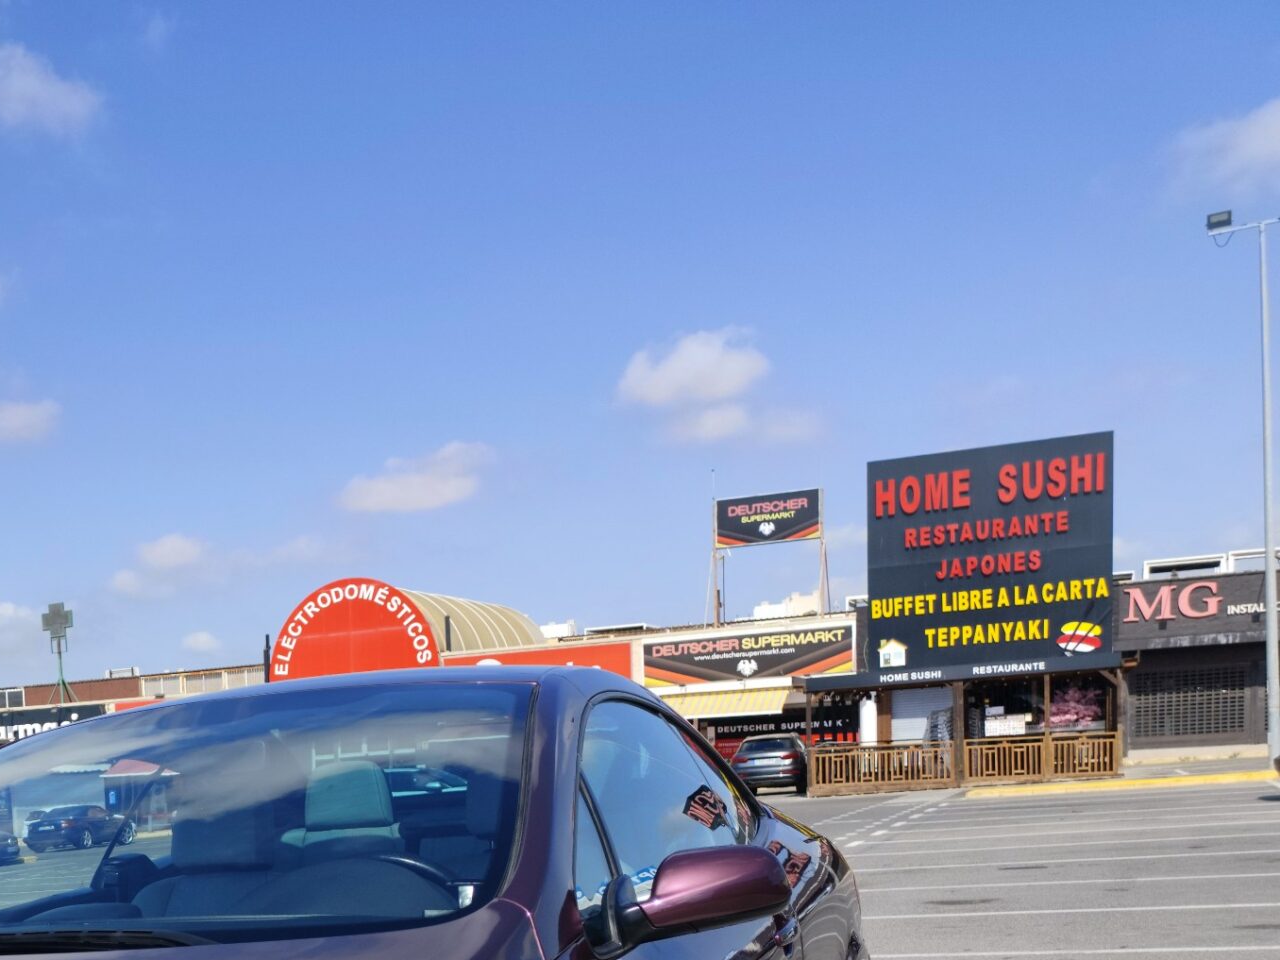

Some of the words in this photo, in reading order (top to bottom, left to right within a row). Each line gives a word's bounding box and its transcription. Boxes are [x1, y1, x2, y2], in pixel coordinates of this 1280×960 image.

[875, 469, 972, 518] HOME
[997, 452, 1106, 505] SUSHI
[727, 497, 808, 517] DEUTSCHER
[741, 510, 796, 523] SUPERMARKT
[904, 510, 1069, 550] RESTAURANTE
[935, 550, 1042, 581] JAPONES
[871, 593, 936, 620] BUFFET
[941, 588, 993, 613] LIBRE
[997, 586, 1011, 608] A
[1014, 584, 1039, 606] LA
[1041, 577, 1109, 604] CARTA
[1122, 581, 1224, 624] MG
[274, 583, 432, 676] ELECTRODOMÉSTICOS
[652, 639, 740, 658] DEUTSCHER
[741, 629, 845, 650] SUPERMARKT
[924, 618, 1050, 649] TEPPANYAKI
[693, 647, 796, 662] www.deutschersupermarkt.com
[972, 661, 1046, 675] RESTAURANTE
[880, 672, 908, 683] HOME
[910, 670, 942, 681] SUSHI
[717, 723, 775, 734] DEUTSCHER
